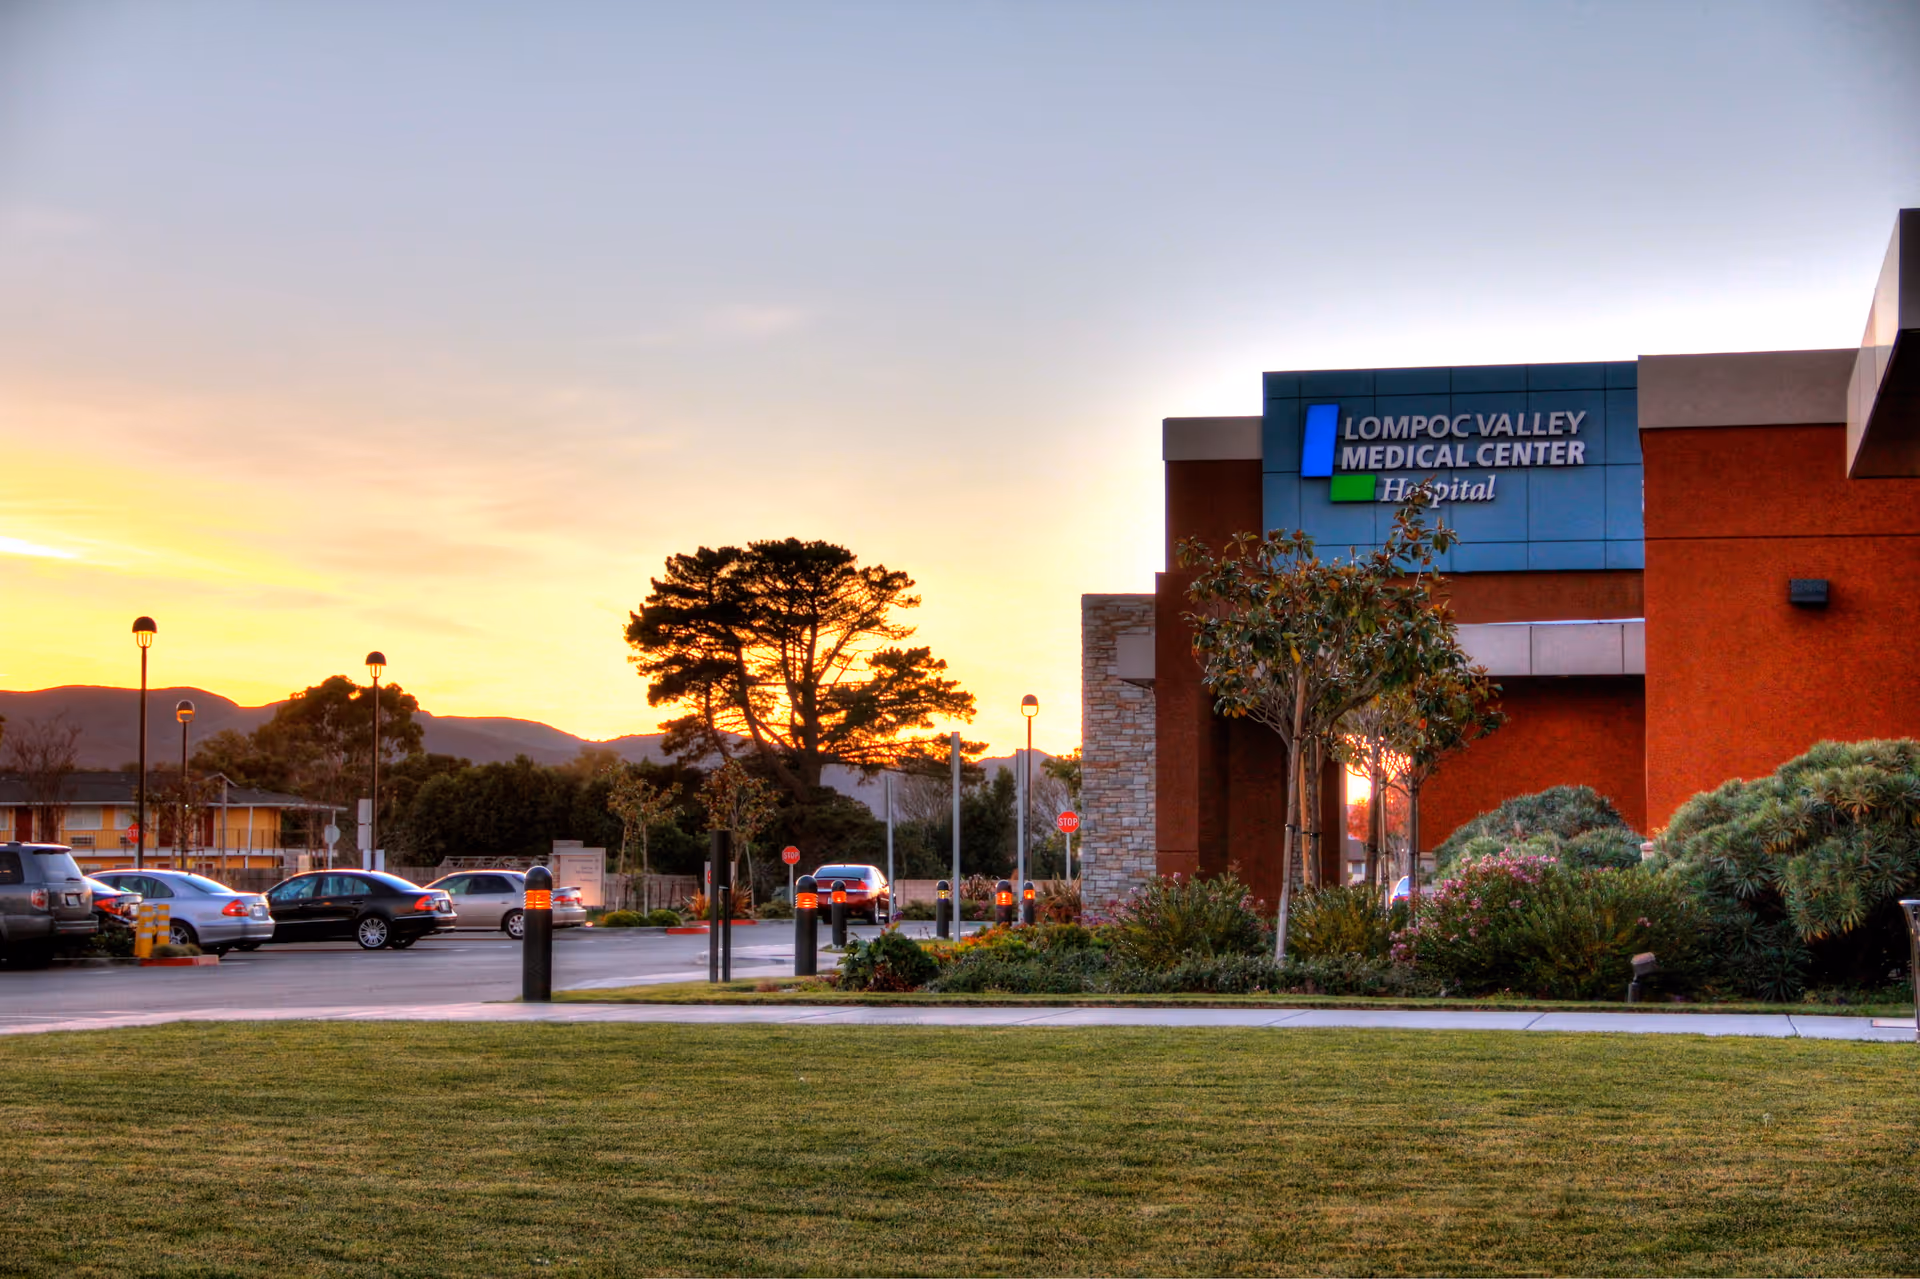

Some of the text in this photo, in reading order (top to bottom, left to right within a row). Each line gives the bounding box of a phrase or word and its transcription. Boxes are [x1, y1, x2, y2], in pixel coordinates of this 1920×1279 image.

[1344, 410, 1586, 440] LOMPOC VALLEY
[1341, 440, 1586, 470] MEDICAL CENTER
[1058, 817, 1078, 826] STOP
[783, 851, 799, 860] STOP
